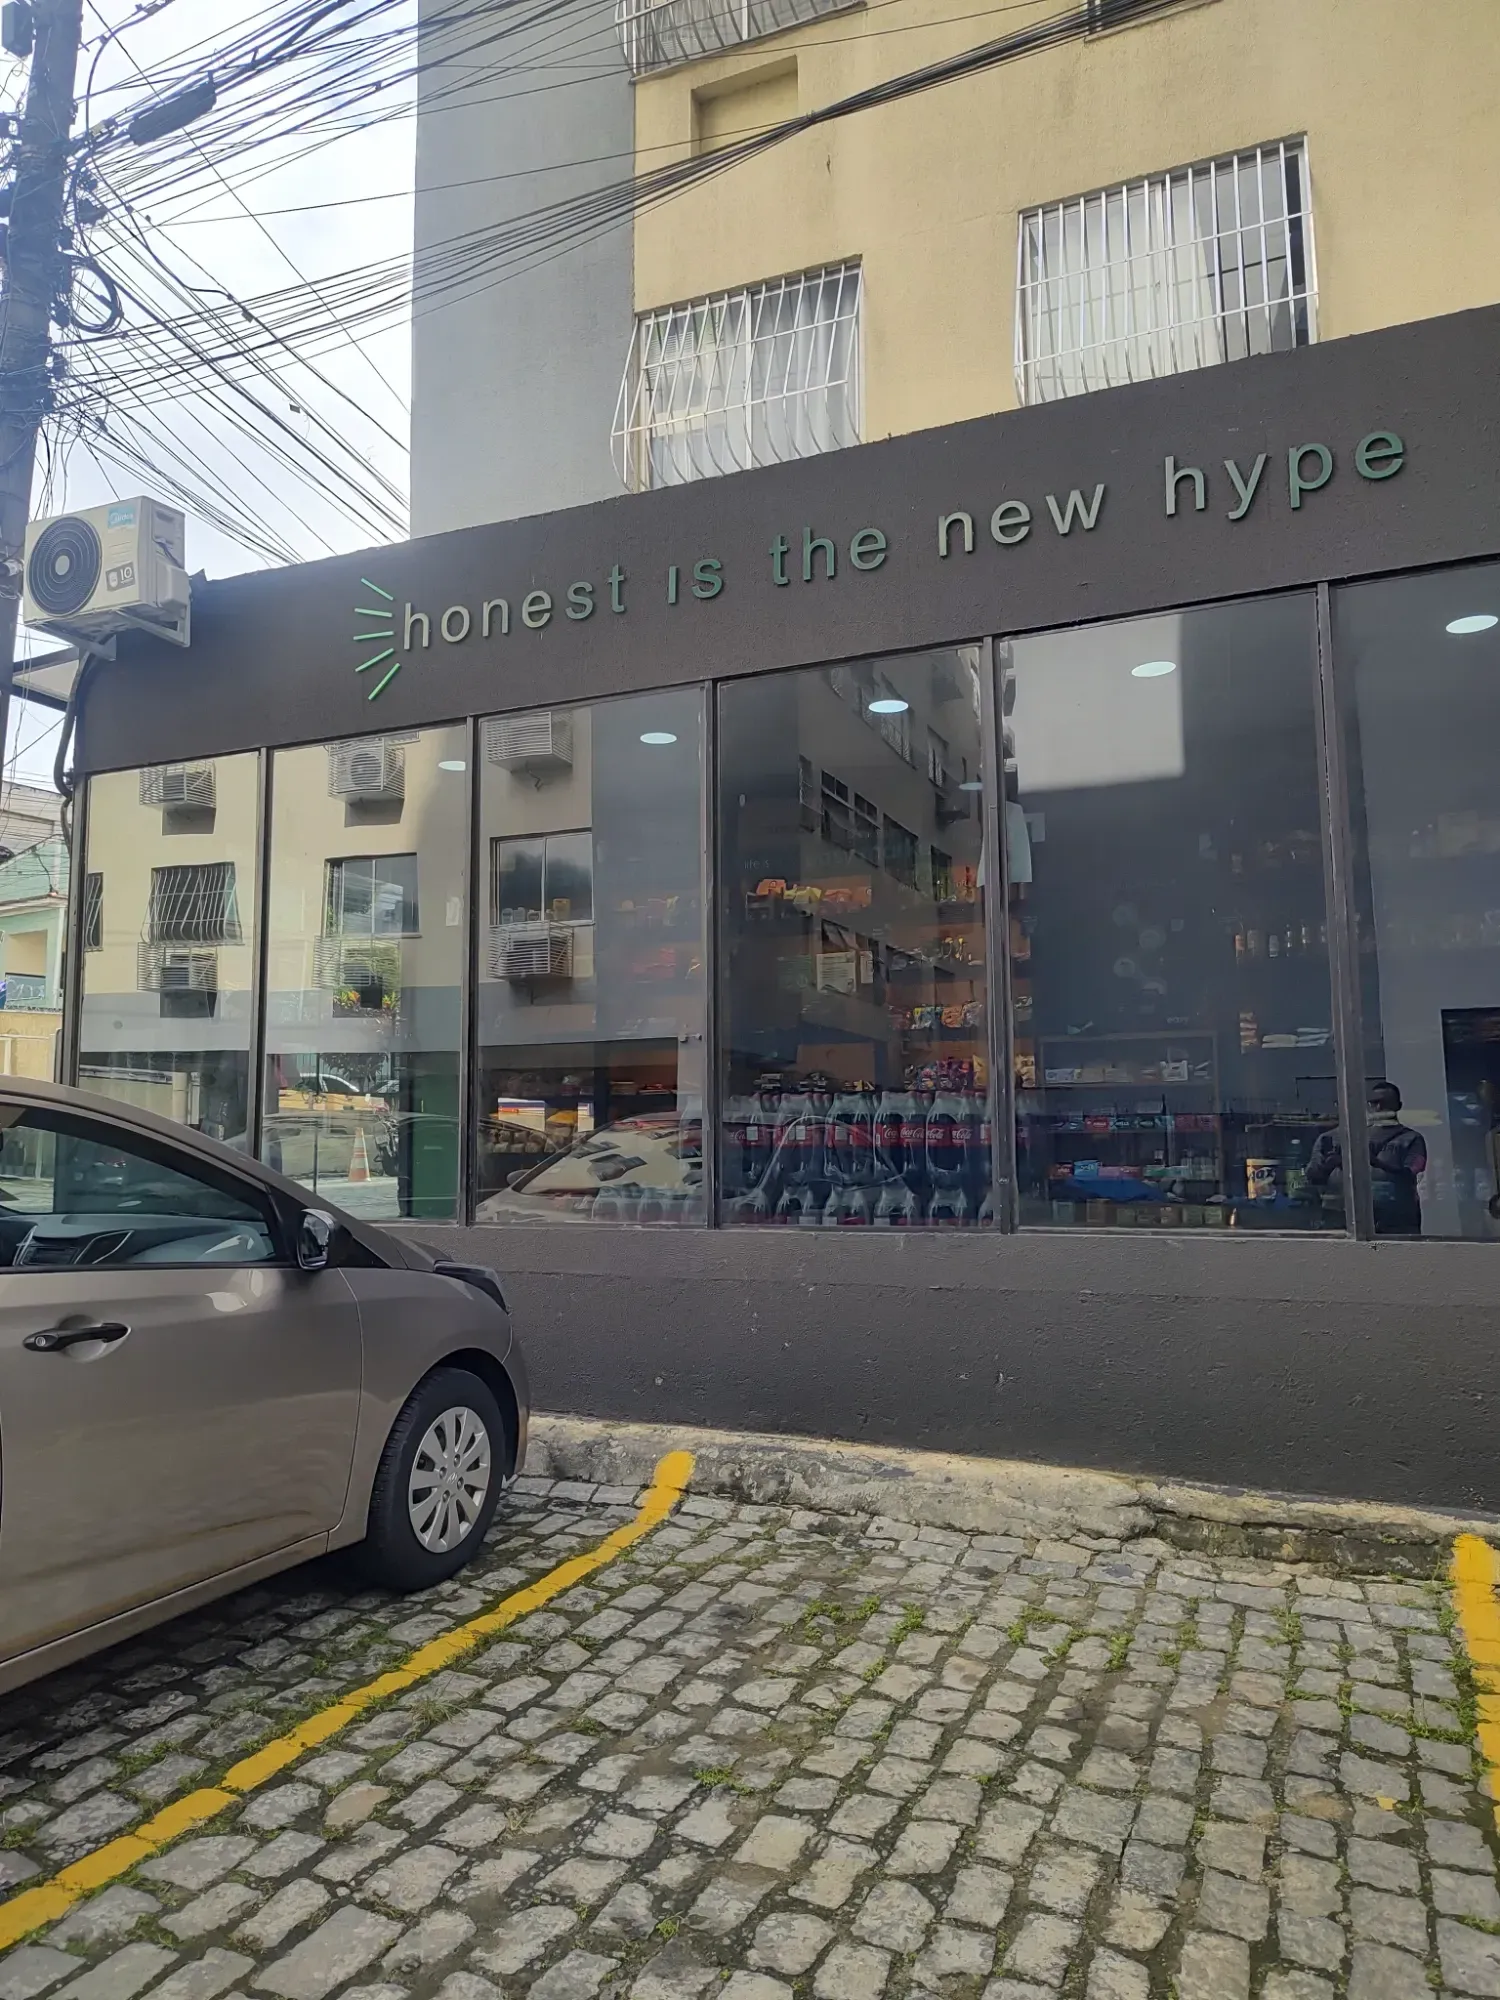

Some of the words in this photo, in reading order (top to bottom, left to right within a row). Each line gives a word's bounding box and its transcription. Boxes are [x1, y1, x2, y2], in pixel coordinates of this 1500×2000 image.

[402, 563, 626, 651] honest
[666, 557, 723, 604] is
[768, 526, 888, 586] the
[937, 483, 1106, 558] new
[1163, 430, 1404, 521] hype
